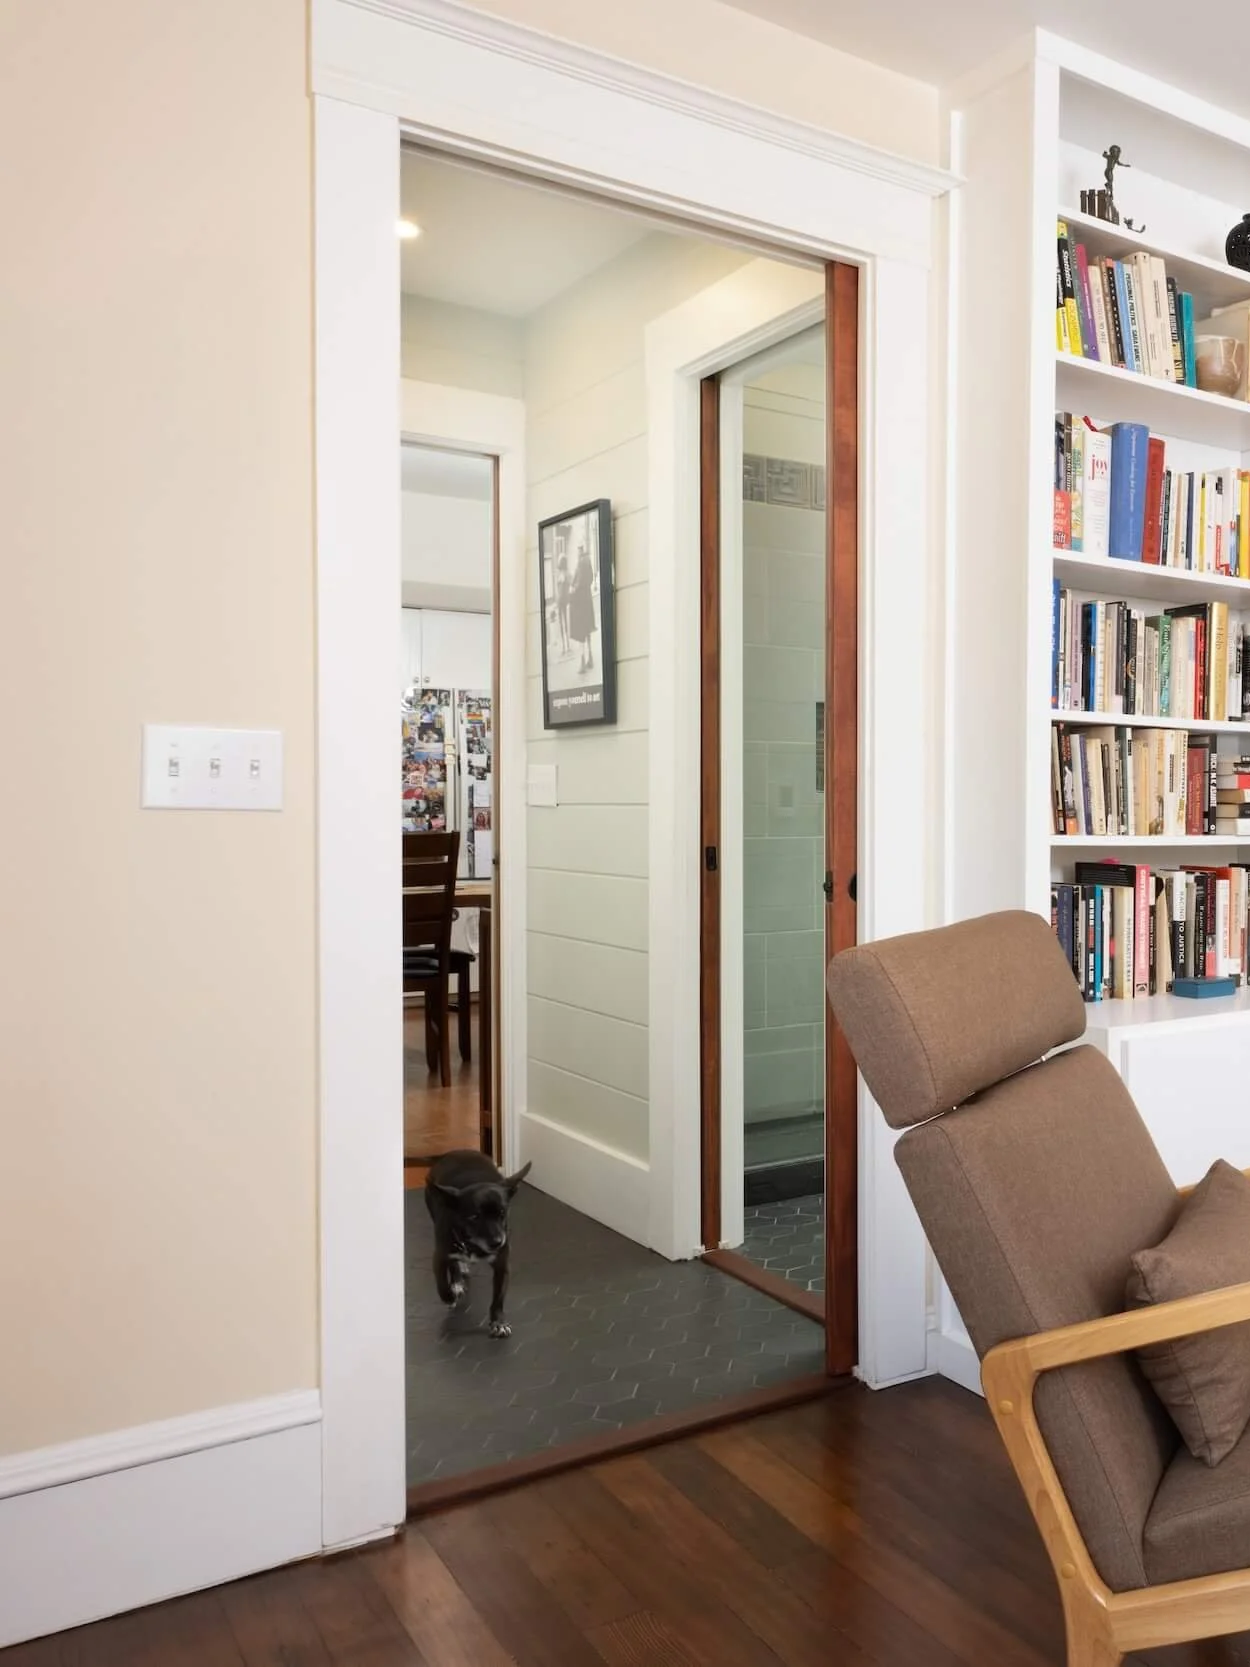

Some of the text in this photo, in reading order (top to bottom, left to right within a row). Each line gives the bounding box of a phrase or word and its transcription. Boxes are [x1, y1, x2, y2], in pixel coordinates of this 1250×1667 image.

[1062, 249, 1073, 288] Statistics
[1125, 273, 1137, 326] PERSONAL POLITICS
[1179, 921, 1185, 932] TO
